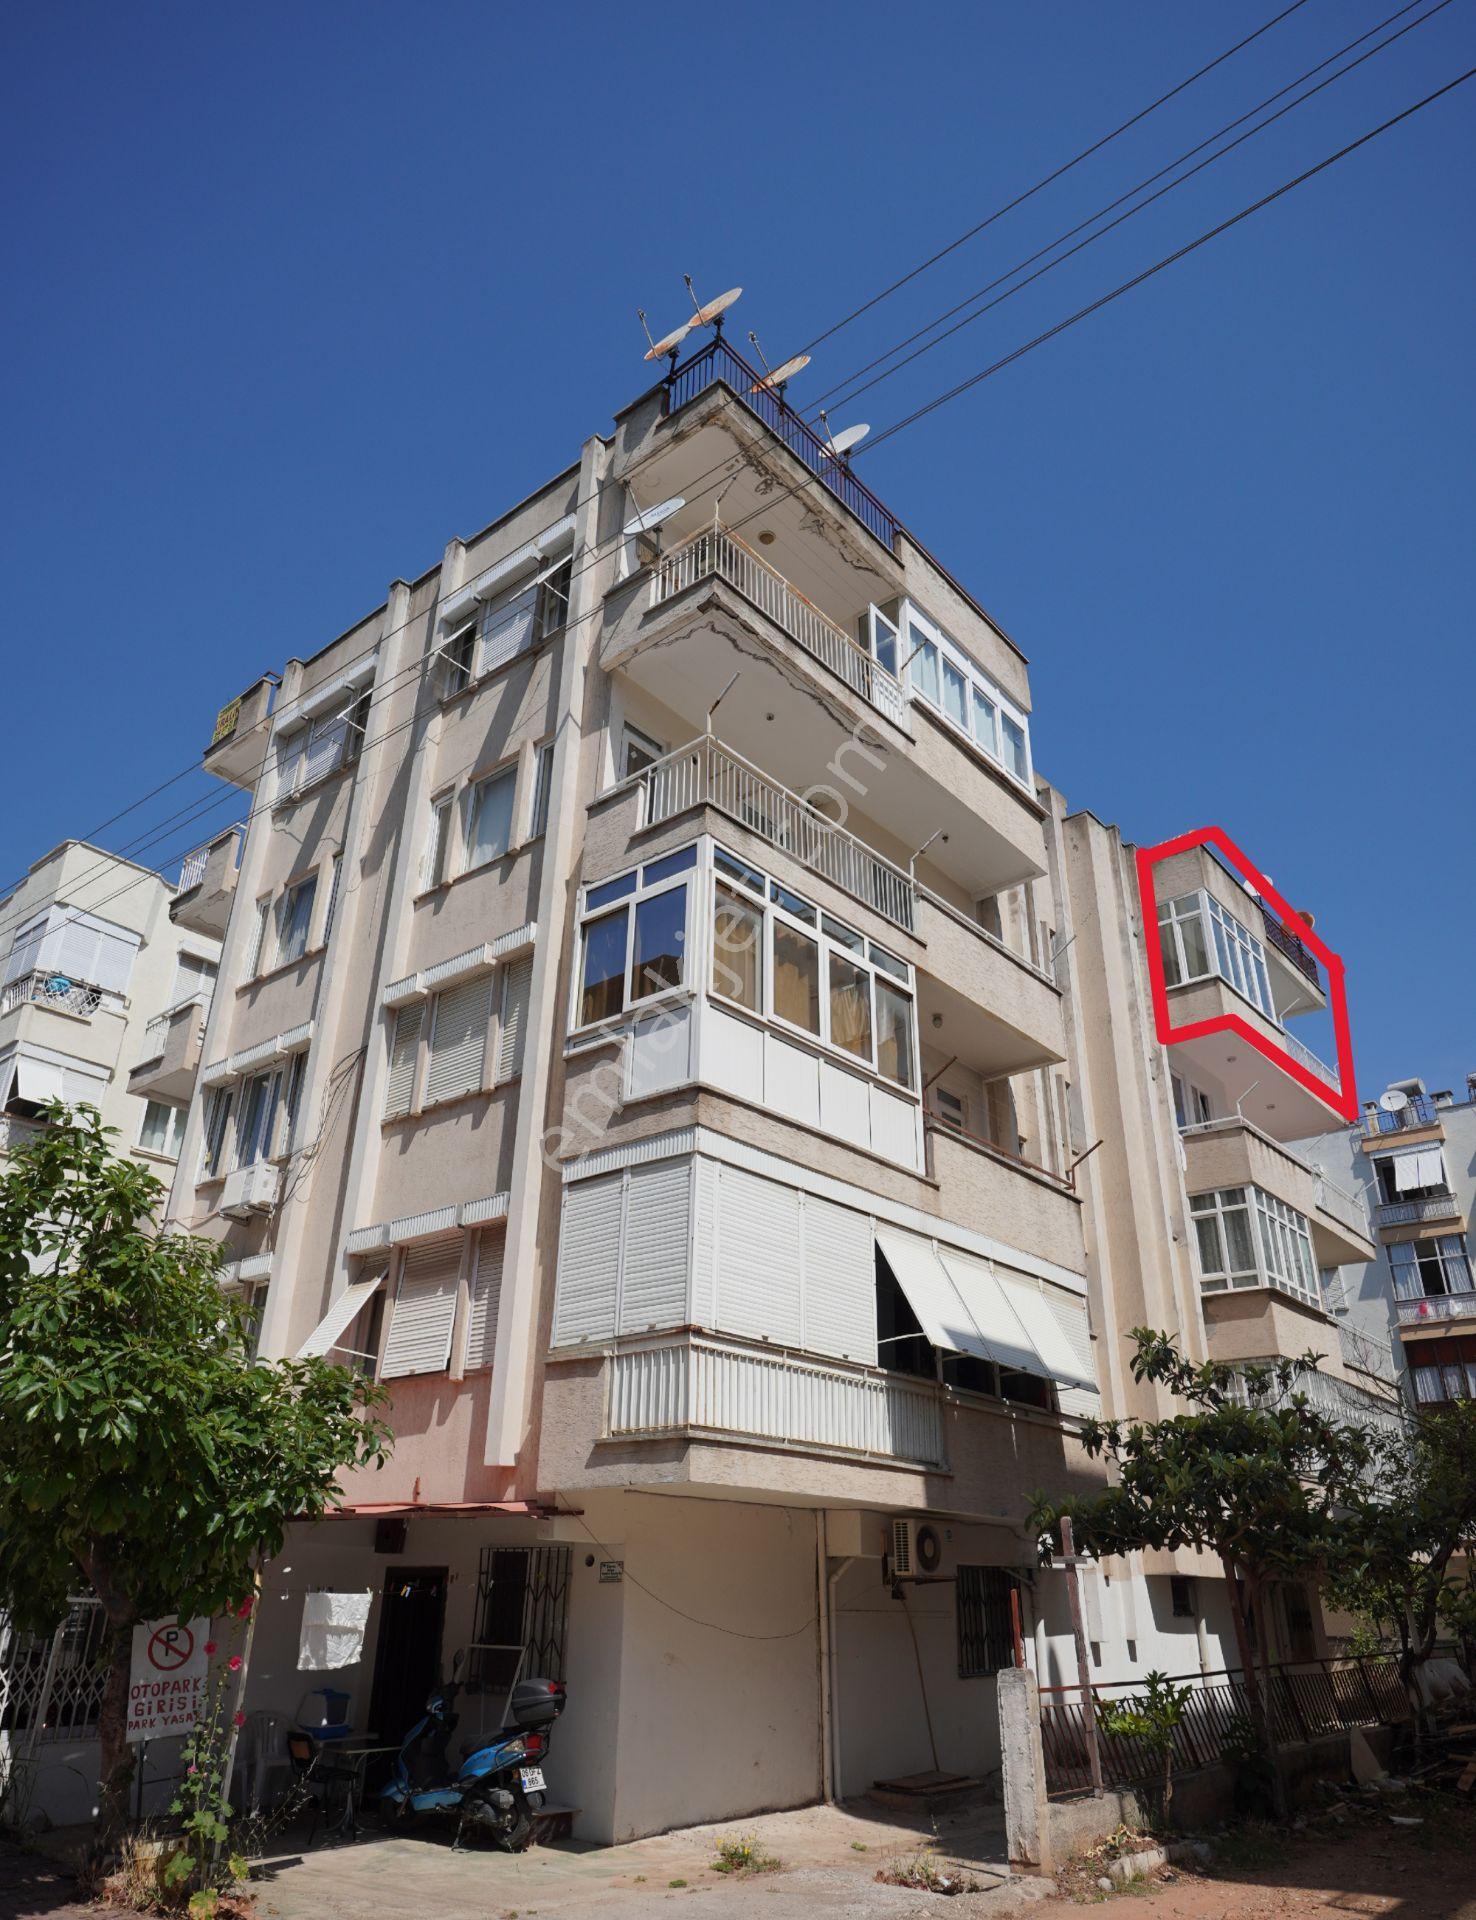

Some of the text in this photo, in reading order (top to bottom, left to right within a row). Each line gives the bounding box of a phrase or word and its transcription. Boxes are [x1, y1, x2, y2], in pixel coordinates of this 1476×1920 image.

[165, 1631, 178, 1656] P
[131, 1678, 201, 1700] OTOPARK
[128, 1718, 156, 1731] PARK
